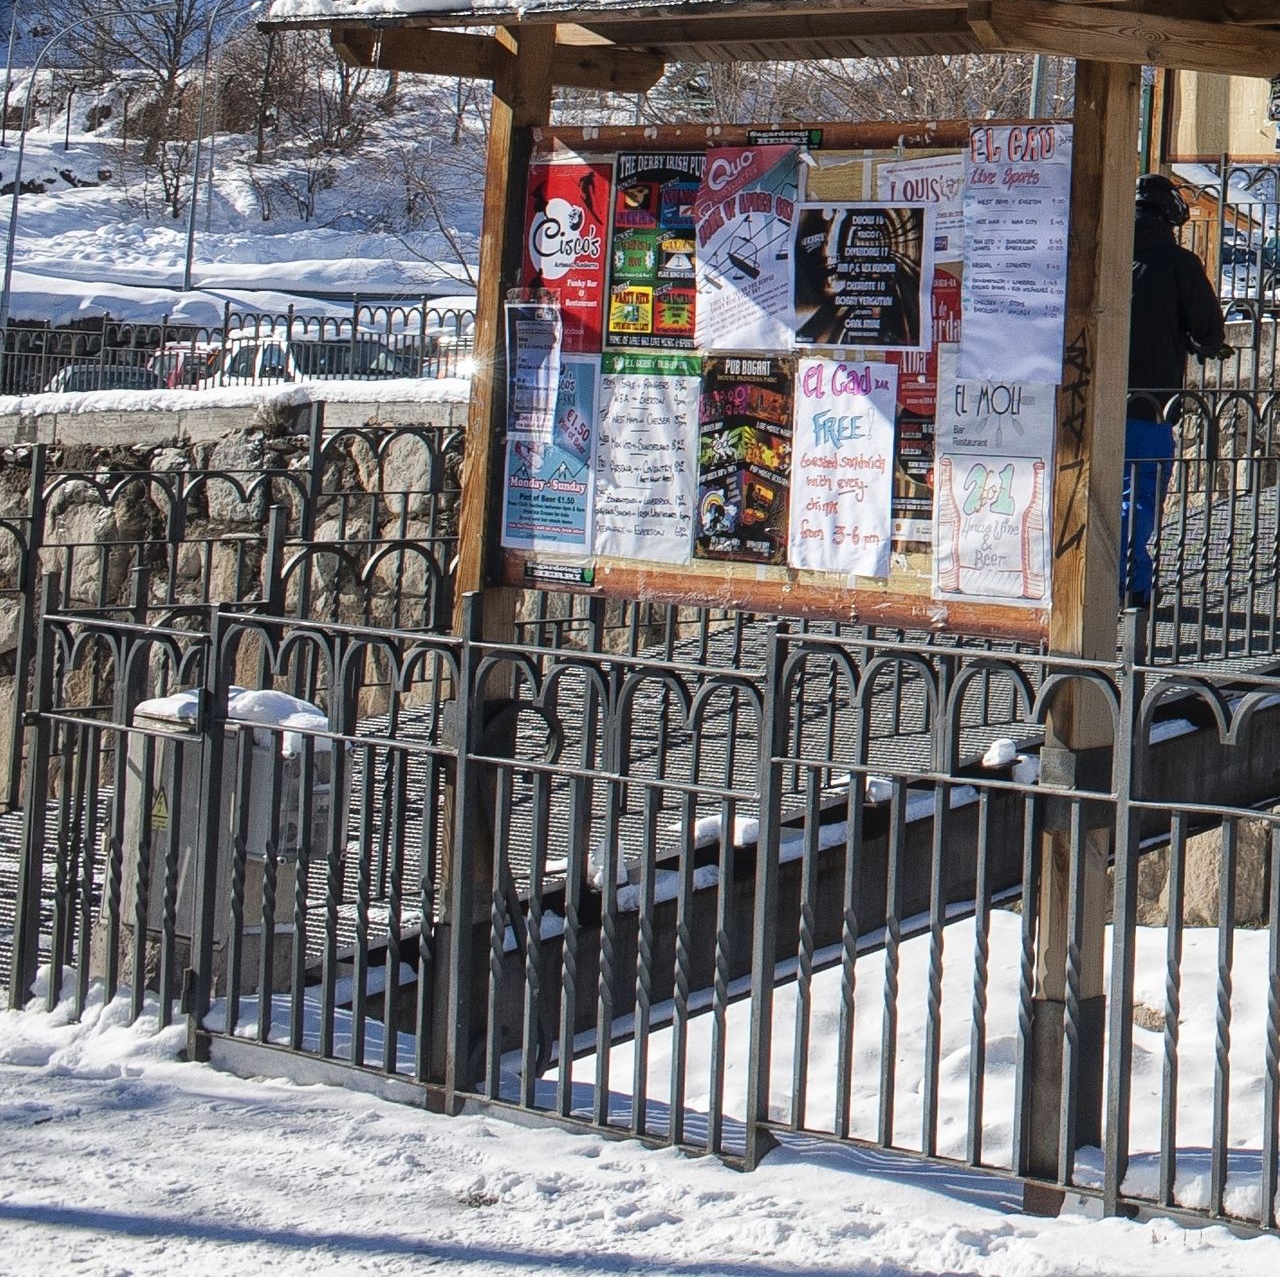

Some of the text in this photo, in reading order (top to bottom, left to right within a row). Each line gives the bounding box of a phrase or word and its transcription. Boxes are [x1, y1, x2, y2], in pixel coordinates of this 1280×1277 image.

[971, 126, 1055, 163] EL CAU
[620, 155, 637, 179] THE
[638, 155, 665, 172] DERBY
[666, 155, 689, 172] IRISH
[708, 151, 757, 191] Quo
[970, 167, 997, 185] Live
[1002, 167, 1040, 191] Sports
[533, 219, 599, 256] Cisco's
[567, 279, 598, 289] Funky Bar
[566, 299, 597, 307] Restaurant
[725, 359, 771, 376] PUB BOGART
[874, 379, 889, 390] BAR
[955, 384, 967, 416] EL
[977, 385, 1022, 416] MOLI
[567, 409, 590, 442] €1.50
[953, 425, 965, 434] Bar
[952, 437, 988, 448] Restaurant
[800, 452, 838, 470] toasted
[839, 453, 886, 474] sandwich
[509, 475, 547, 491] Monday
[551, 479, 587, 495] Sunday
[806, 473, 868, 502] with every
[963, 463, 1015, 516] 2 1
[519, 493, 532, 501] Pint
[541, 495, 556, 503] Beer
[806, 497, 839, 517] drink
[800, 519, 880, 551] from 3-6 pm
[975, 549, 1007, 571] Beer
